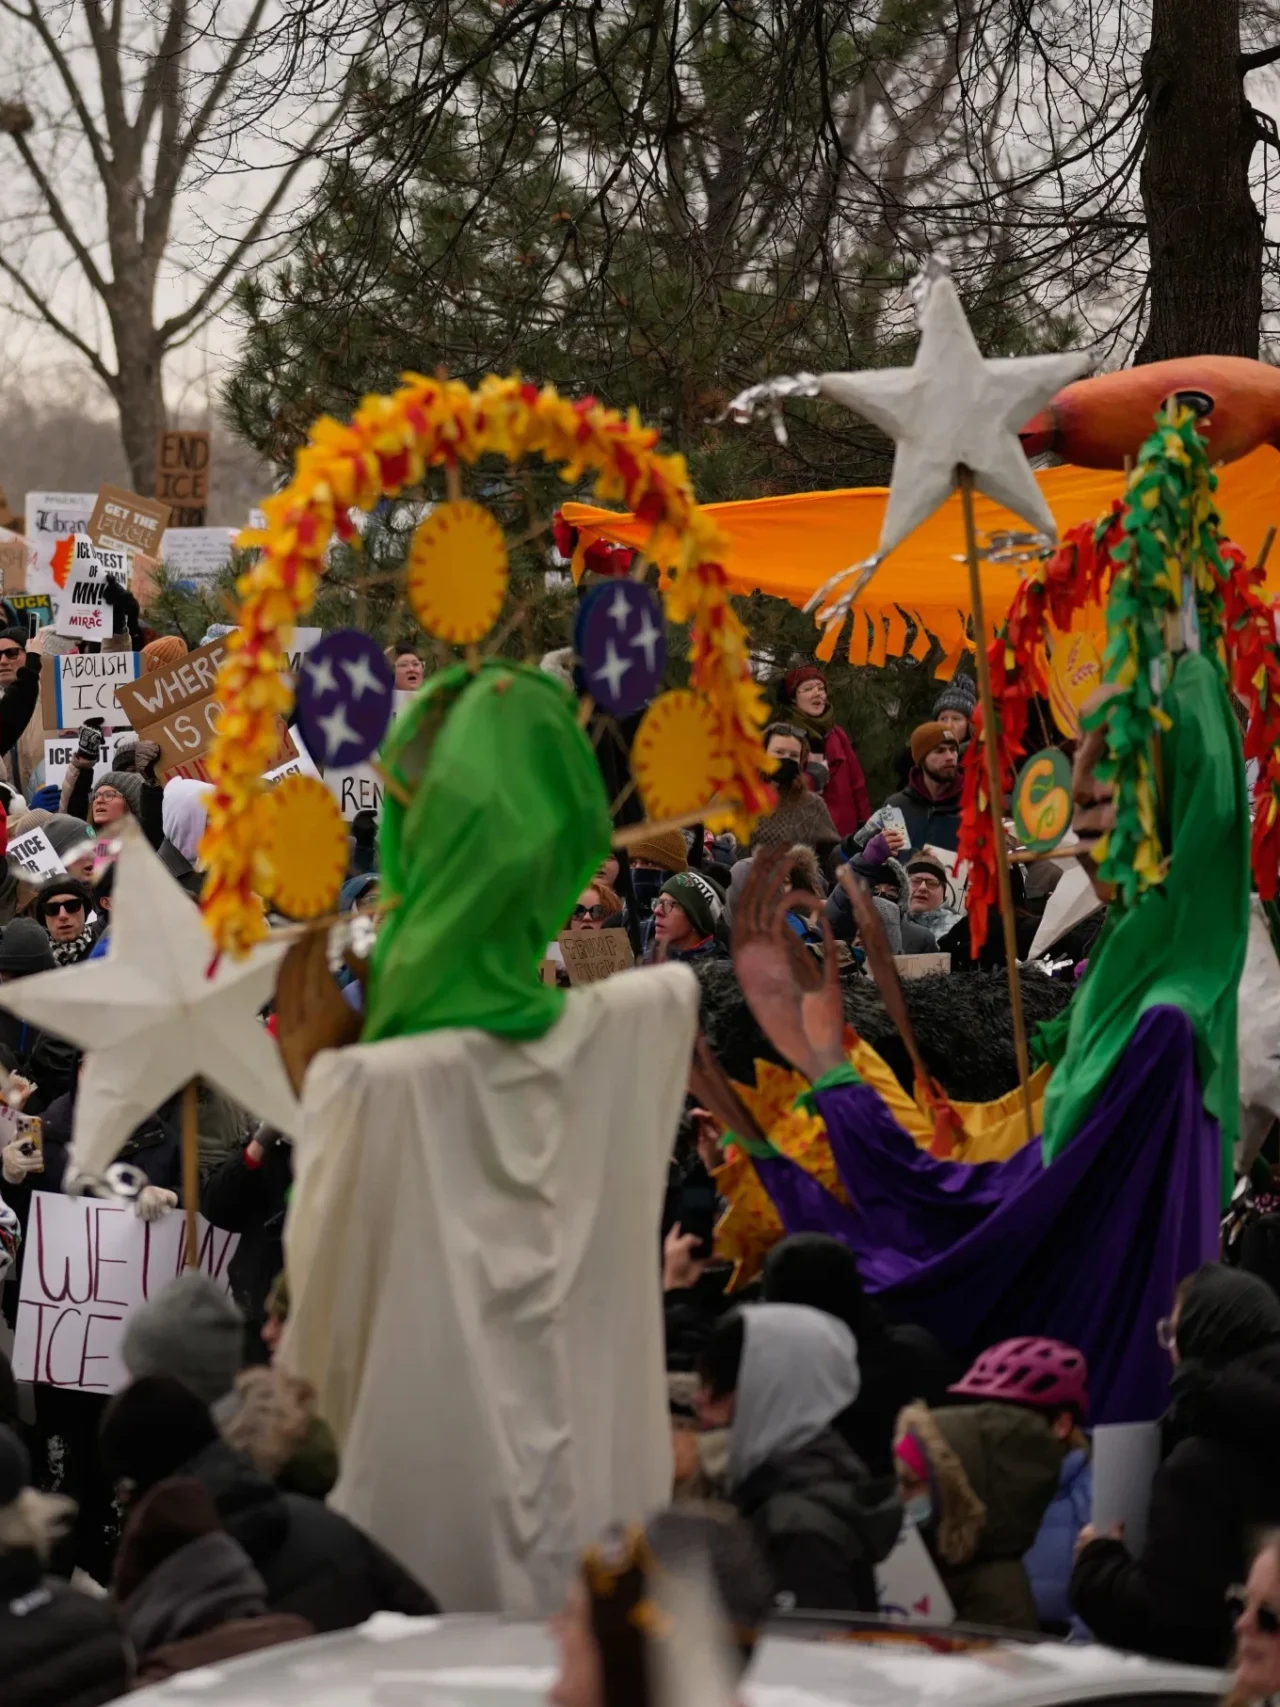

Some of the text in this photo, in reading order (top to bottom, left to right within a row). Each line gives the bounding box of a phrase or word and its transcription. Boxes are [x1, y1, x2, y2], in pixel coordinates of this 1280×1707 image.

[162, 436, 209, 471] END
[161, 473, 206, 499] ICE
[104, 503, 130, 519] GET
[133, 512, 159, 531] THE
[96, 513, 154, 549] FUCK
[76, 541, 91, 559] ICE
[88, 565, 99, 578] OF
[14, 595, 49, 610] UCK
[72, 582, 106, 606] MN!
[69, 616, 103, 629] MIRAC
[62, 653, 127, 679] ABOLISH
[132, 647, 225, 714] WHERE
[70, 683, 127, 711] ICE
[163, 715, 201, 753] IS
[49, 747, 72, 765] ICE
[564, 936, 617, 960] TRUMP
[17, 1299, 123, 1388] ICE
